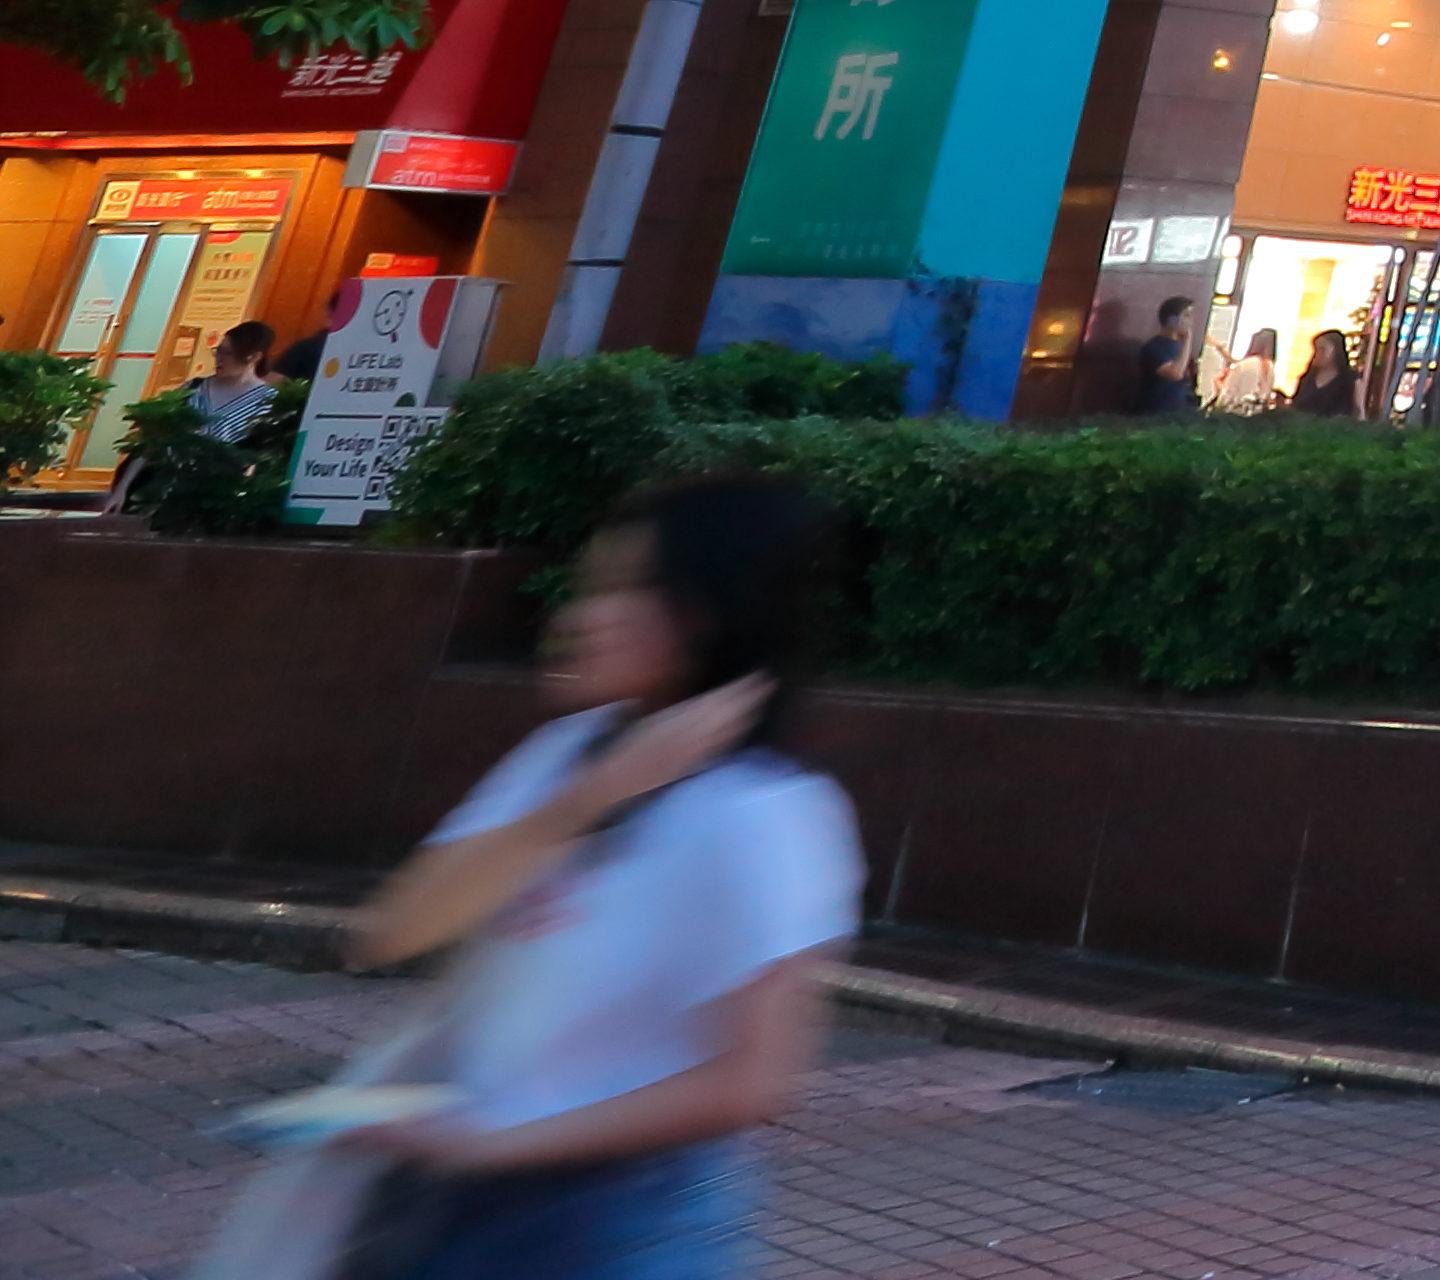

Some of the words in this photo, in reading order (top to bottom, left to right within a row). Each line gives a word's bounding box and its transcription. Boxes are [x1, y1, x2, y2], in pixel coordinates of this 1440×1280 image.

[347, 353, 379, 370] LIFE
[325, 432, 375, 456] Design
[304, 459, 337, 477] Your
[339, 460, 368, 478] Life
